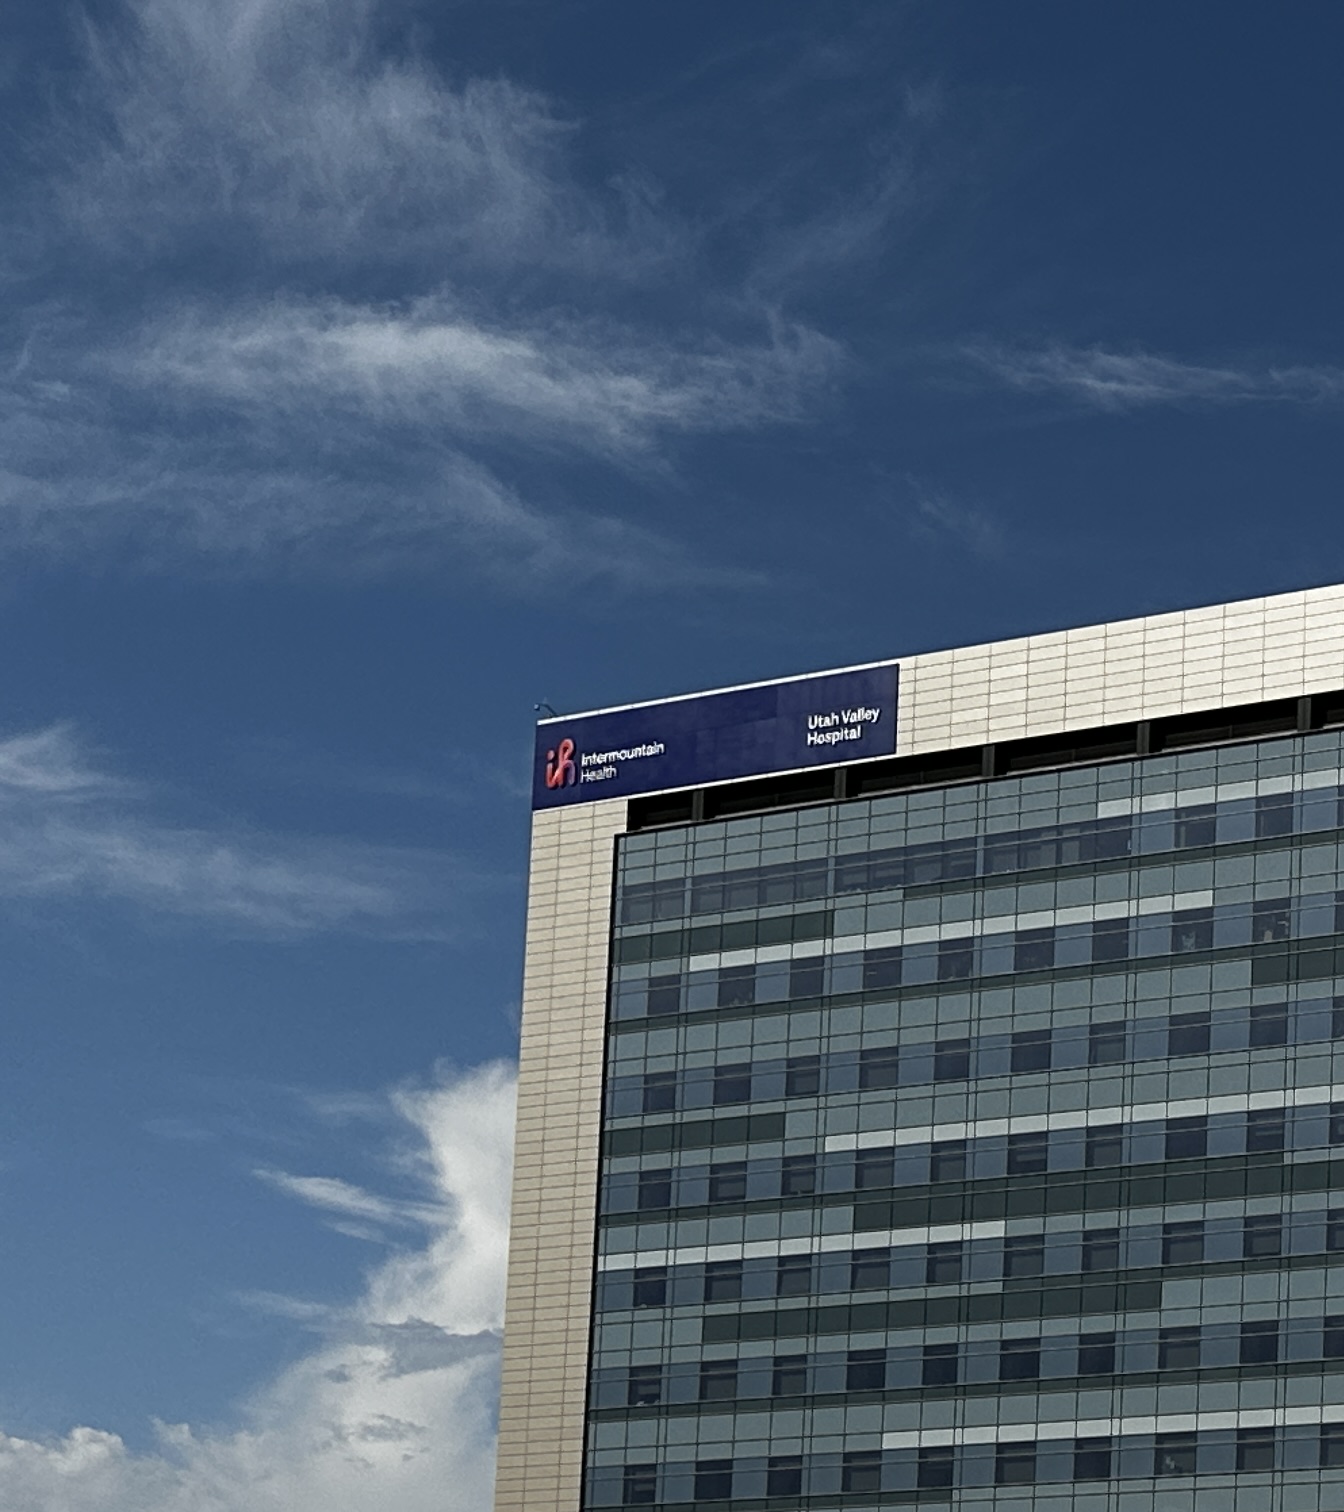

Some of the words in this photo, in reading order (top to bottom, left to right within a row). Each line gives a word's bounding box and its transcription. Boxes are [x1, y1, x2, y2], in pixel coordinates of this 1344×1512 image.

[808, 711, 840, 730] Utah
[841, 706, 880, 723] Valley
[806, 724, 861, 746] Hospital
[581, 740, 665, 768] Intermountain
[580, 765, 617, 784] Health
